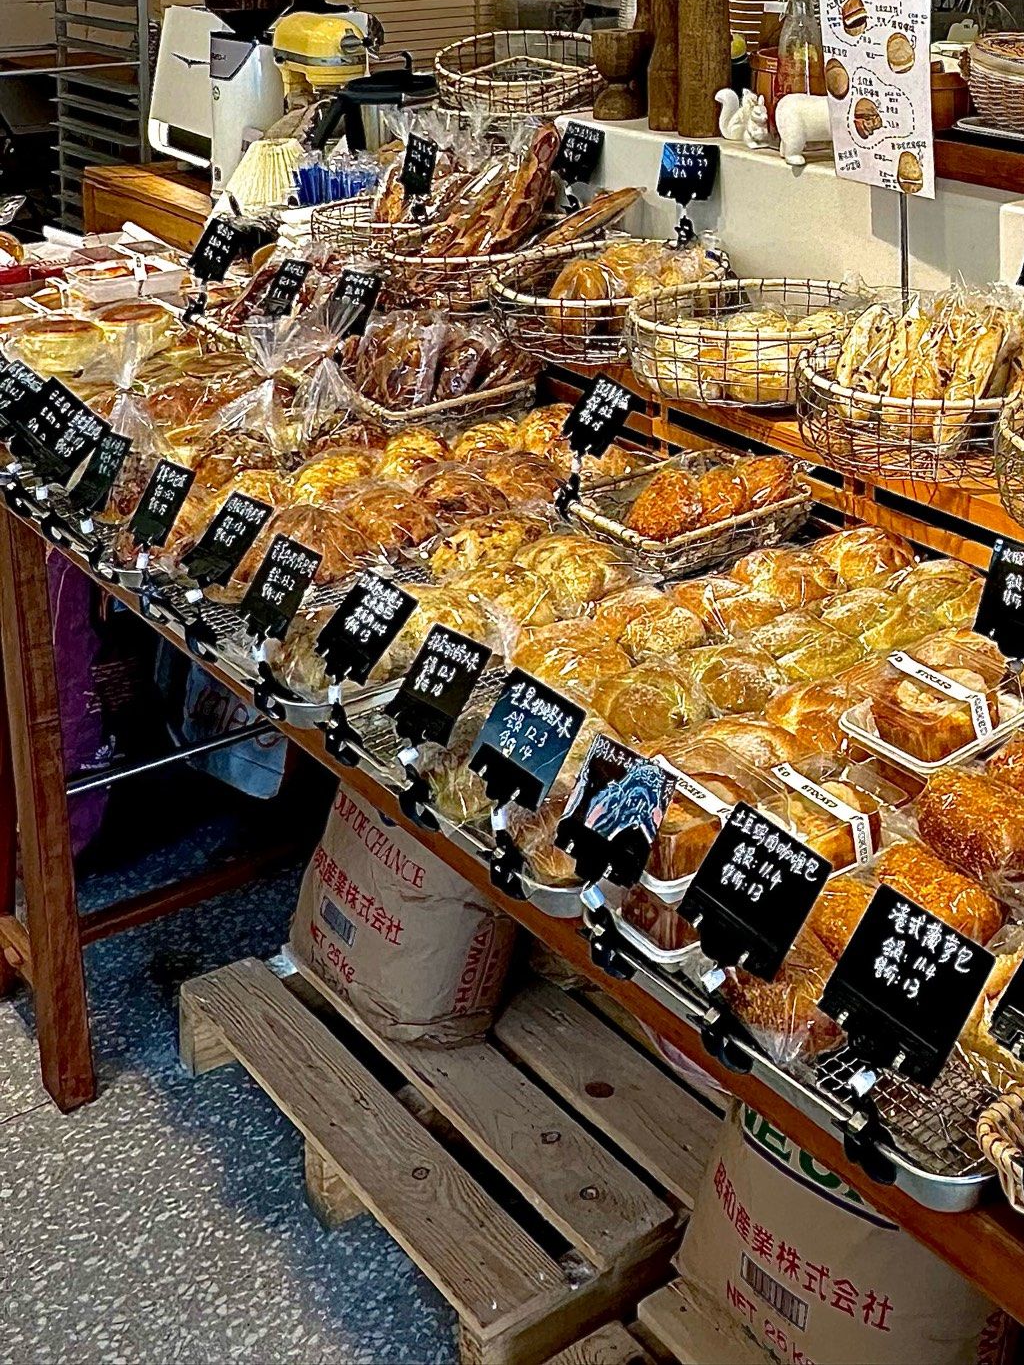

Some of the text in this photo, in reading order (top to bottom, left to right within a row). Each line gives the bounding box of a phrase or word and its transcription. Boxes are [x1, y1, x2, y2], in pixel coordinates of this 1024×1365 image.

[352, 810, 370, 838] DE
[365, 826, 426, 888] CHANCE
[713, 1156, 894, 1332] 昭和産業株式会社
[727, 1279, 757, 1323] NET
